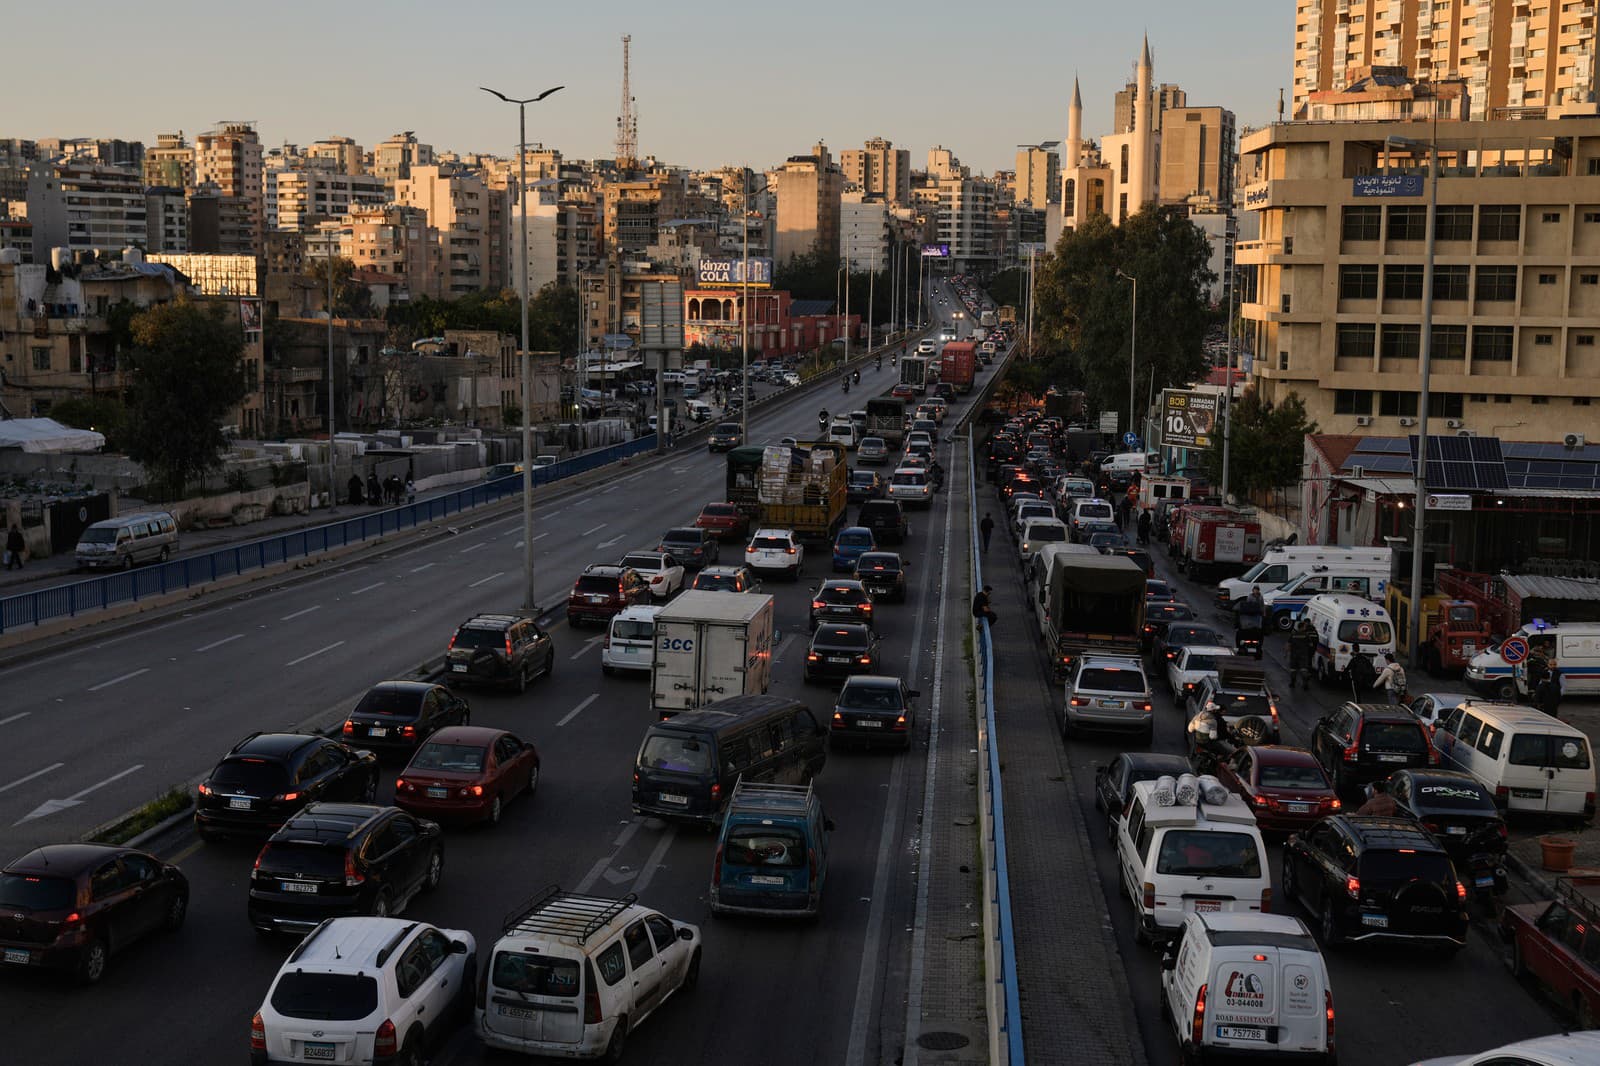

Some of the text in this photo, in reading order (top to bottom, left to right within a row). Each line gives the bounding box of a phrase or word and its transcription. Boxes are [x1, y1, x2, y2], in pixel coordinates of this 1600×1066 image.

[700, 260, 730, 272] kinza
[700, 271, 730, 281] COLA
[1169, 397, 1185, 406] BOB
[1215, 1013, 1275, 1024] ROAD ASSISTANCE
